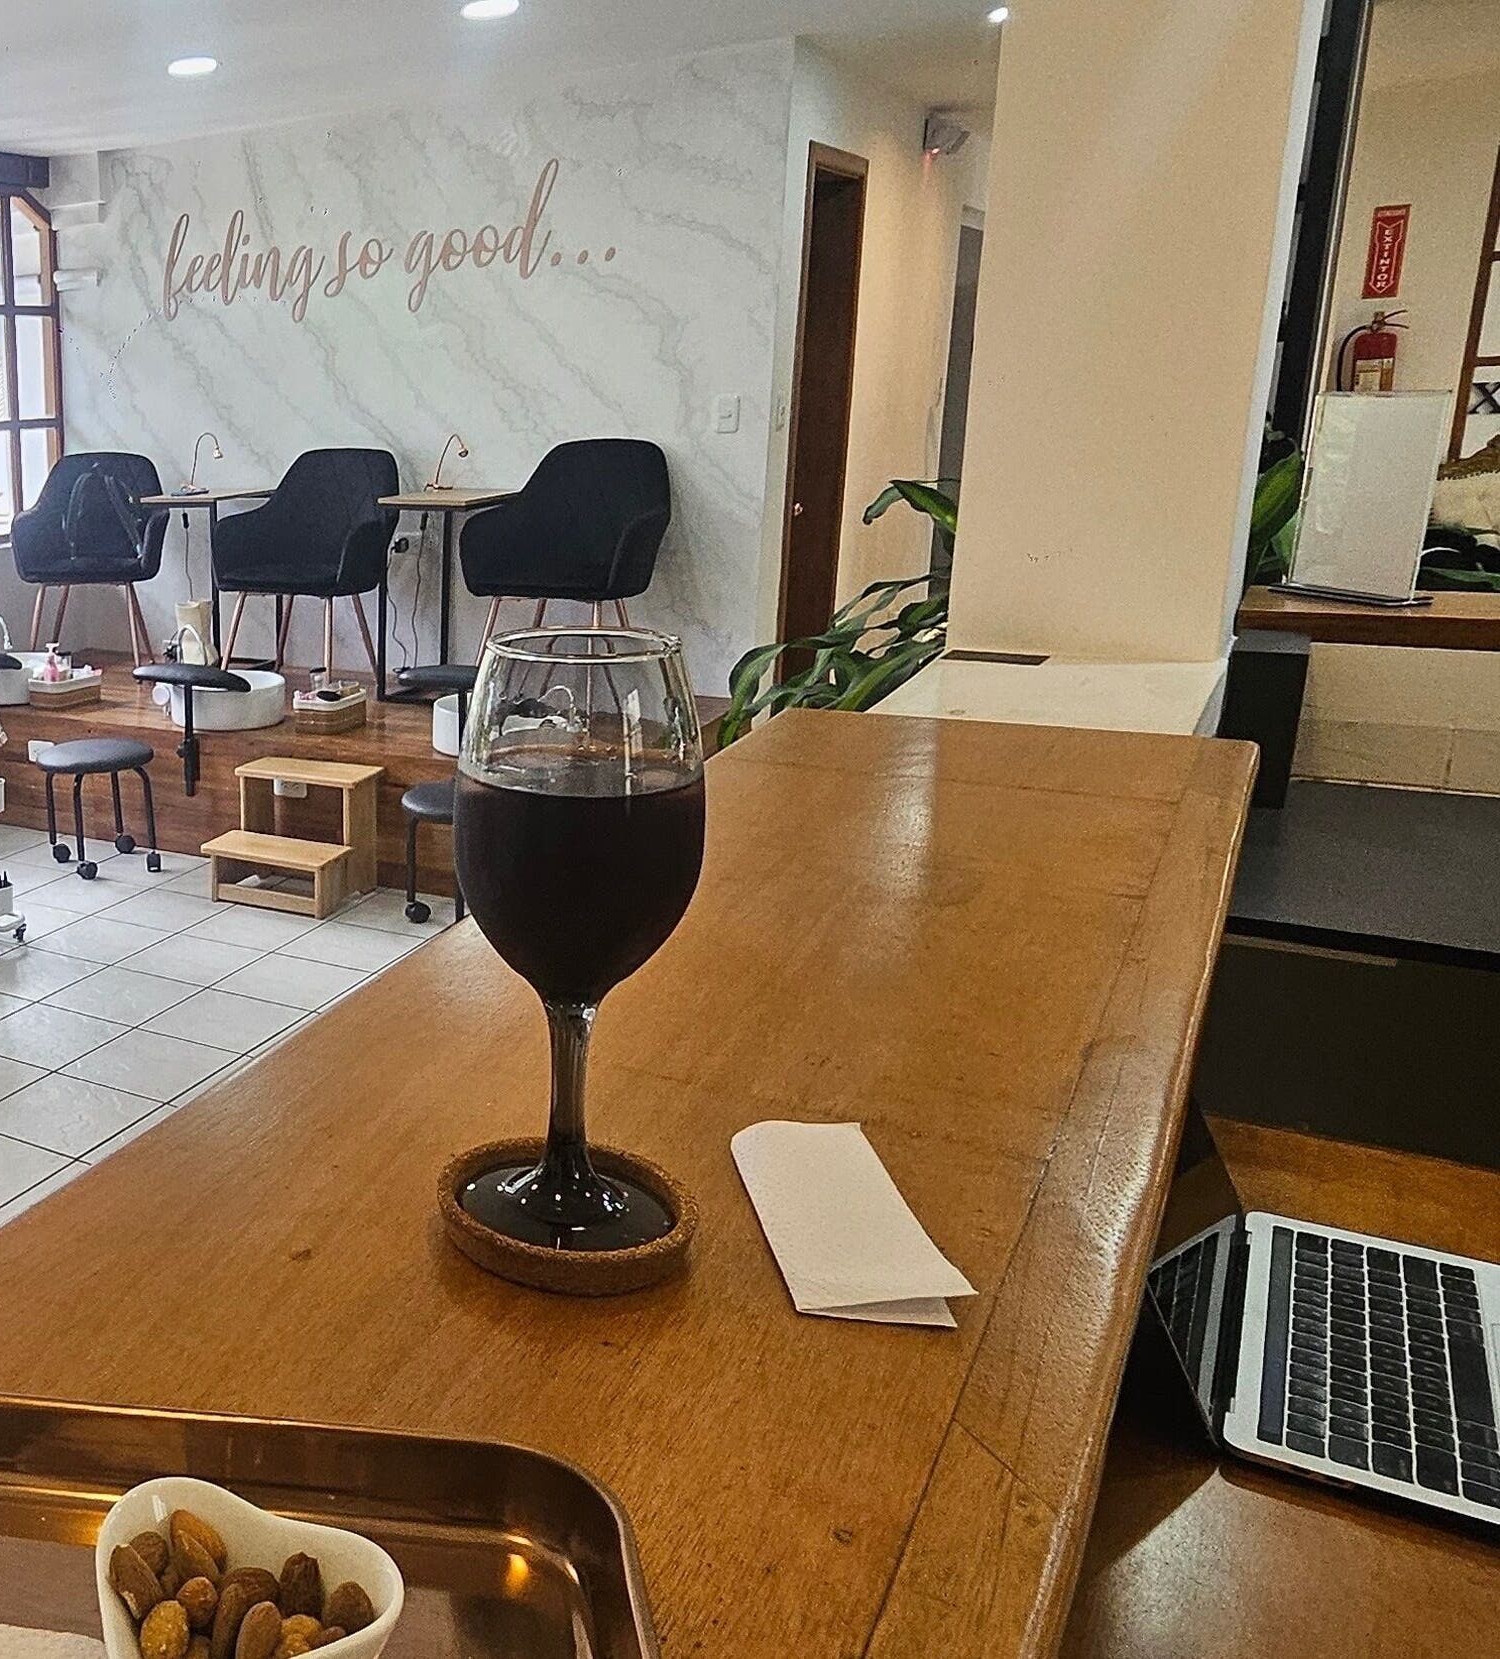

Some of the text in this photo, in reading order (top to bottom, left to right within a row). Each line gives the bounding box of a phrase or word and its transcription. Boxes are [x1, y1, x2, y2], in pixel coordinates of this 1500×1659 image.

[164, 158, 617, 323] feeling so good...
[1375, 229, 1394, 288] EXTINTOR
